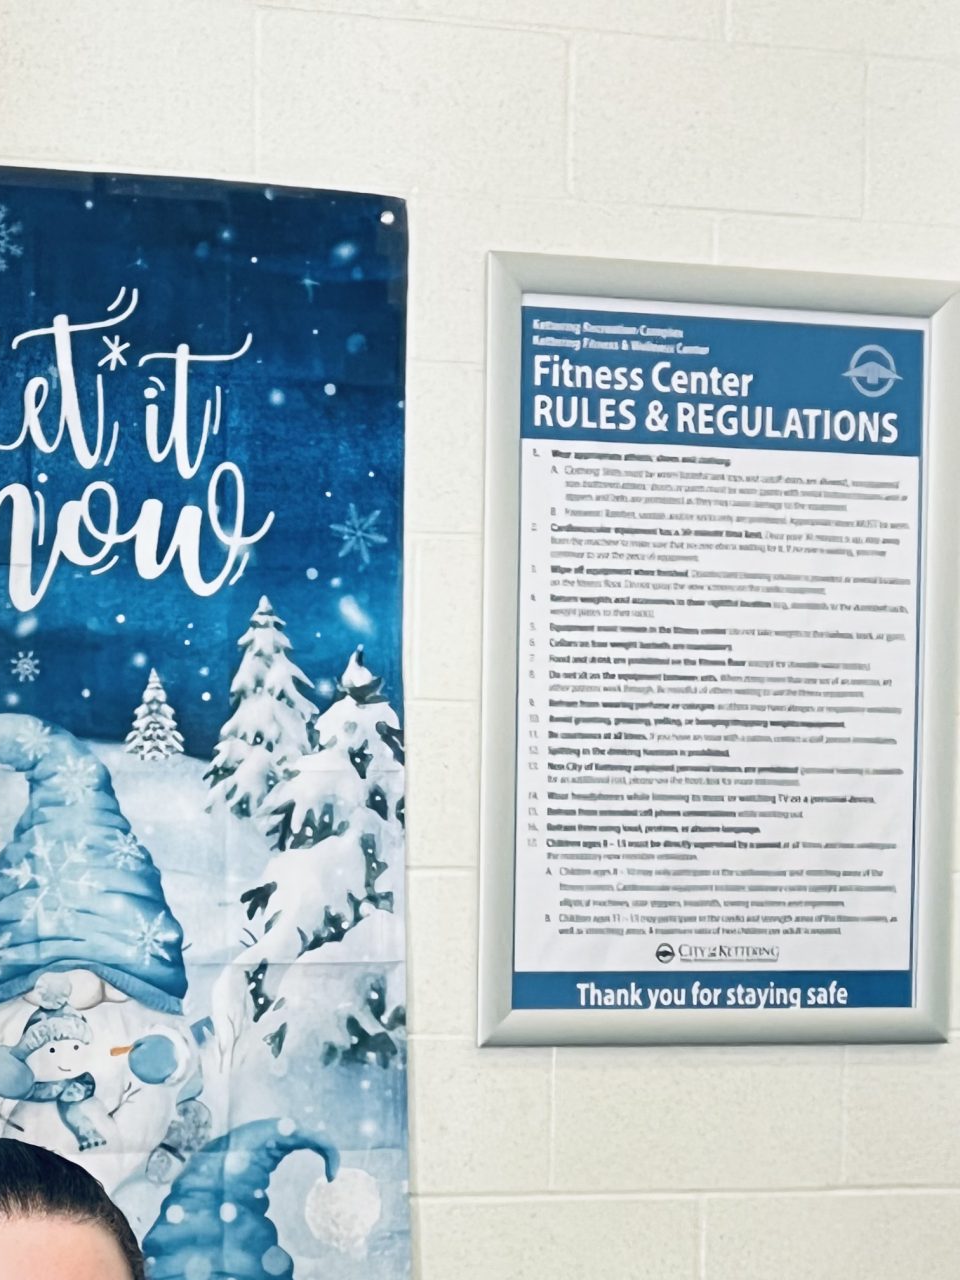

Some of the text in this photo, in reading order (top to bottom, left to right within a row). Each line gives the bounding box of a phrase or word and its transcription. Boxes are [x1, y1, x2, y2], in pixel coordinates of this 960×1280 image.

[534, 354, 754, 397] Fitness Center
[139, 333, 252, 479] it
[534, 394, 898, 444] RULES & REGULATIONS
[576, 980, 849, 1010] Thank you for staying safe
